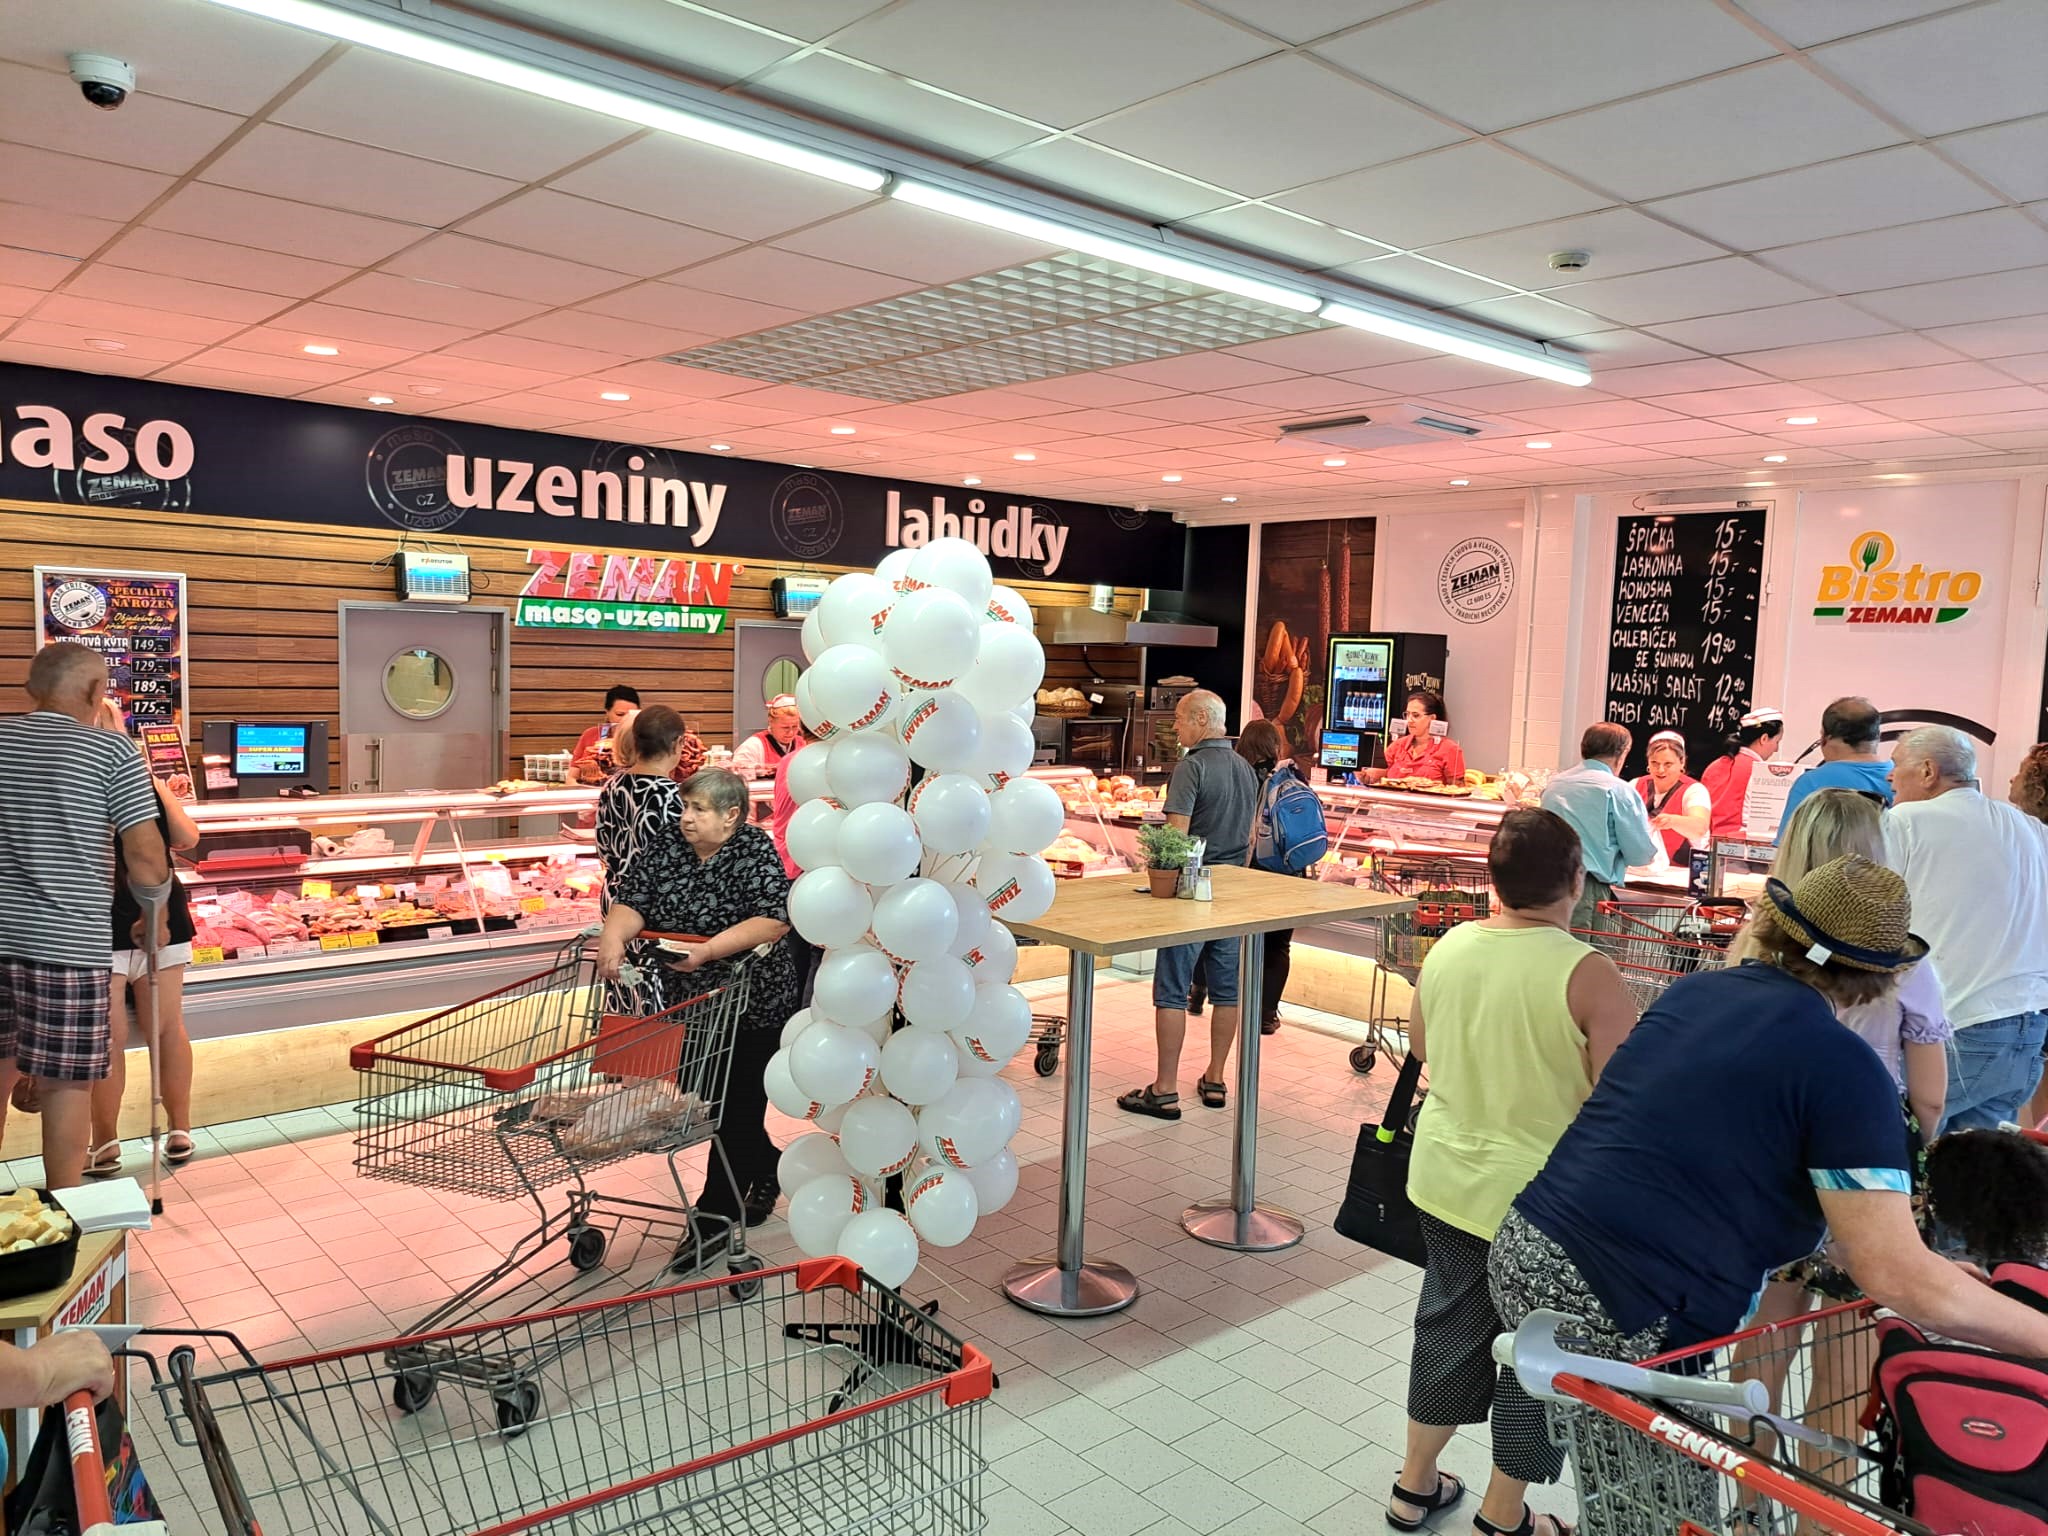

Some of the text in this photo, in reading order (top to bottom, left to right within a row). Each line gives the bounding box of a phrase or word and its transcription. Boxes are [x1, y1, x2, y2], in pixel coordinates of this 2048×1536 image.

[0, 404, 195, 480] aso
[416, 493, 436, 506] CZ
[446, 454, 727, 547] uzeniny
[787, 505, 827, 520] ZEMAN
[885, 490, 1070, 576] lahůdky
[1626, 522, 1675, 552] ŠPIČKA
[519, 548, 735, 606] ZEMAN
[1451, 564, 1500, 591] ZEMAN
[1622, 554, 1683, 578] LASKONKA
[1816, 531, 1983, 602] Bistro
[63, 596, 90, 611] ZEMAN
[107, 587, 175, 597] SPECIALITY
[111, 596, 174, 609] NA ROŽEŇ
[525, 605, 722, 633] maso-uzeniny
[1616, 601, 1669, 624] VĚNEČEK
[1847, 607, 1933, 623] ZEMAN
[104, 633, 129, 647] KÝTA
[1612, 626, 1677, 649] CHLEBÍČEK
[1635, 650, 1649, 668] SE
[890, 667, 957, 689] ZEMAN
[1610, 669, 1658, 695] VLAŠSKÝ
[1664, 674, 1705, 703] SALÁT
[848, 688, 889, 731] ZEMAN
[903, 702, 939, 744] ZEMAN
[1608, 700, 1644, 723] RYBÍ
[1648, 702, 1688, 727] SALÁT
[910, 1176, 944, 1209] ZEMAN
[60, 1267, 108, 1326] ZEMAN
[1649, 1415, 1749, 1471] PENNY
